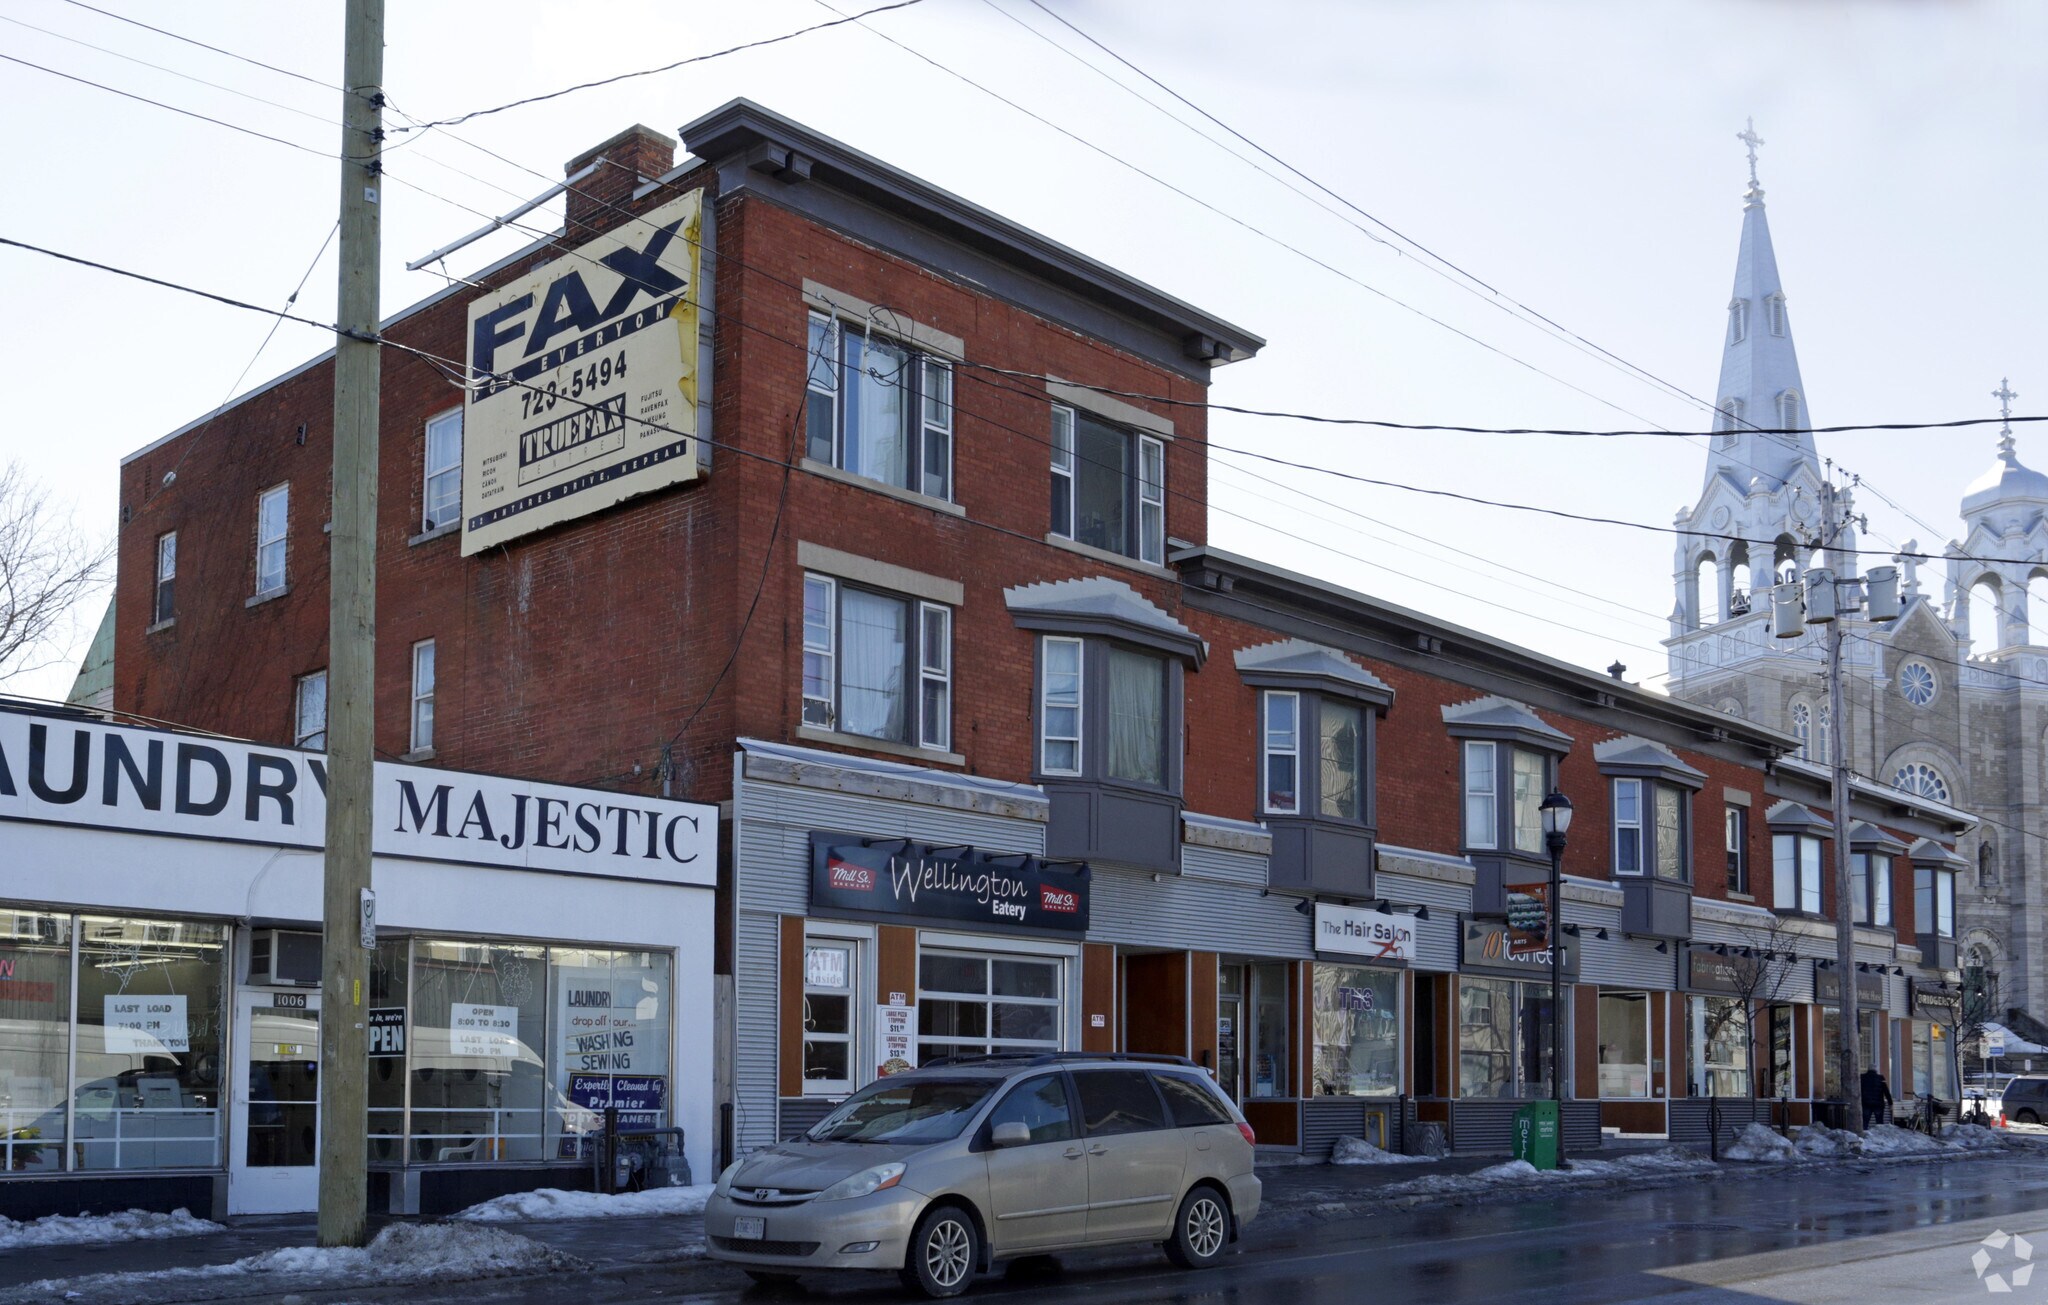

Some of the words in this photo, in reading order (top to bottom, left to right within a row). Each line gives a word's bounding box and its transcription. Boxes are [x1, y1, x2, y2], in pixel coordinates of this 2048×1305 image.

[473, 216, 689, 384] FAX
[540, 302, 664, 372] EVERYON
[521, 350, 627, 420] 723-5494
[640, 389, 663, 403] FUJITSU
[640, 400, 669, 415] RAVENFAX
[522, 397, 624, 462] TRUEFAX
[482, 451, 507, 466] MITSUBISHI
[493, 491, 552, 520] ANTARES
[563, 472, 610, 495] DRIVE,
[621, 444, 681, 474] NEPEAN
[0, 724, 327, 826] UNDR
[393, 779, 699, 864] MAJESTIC
[832, 867, 855, 881] Mill
[857, 870, 871, 884] St.
[891, 856, 1028, 904] Wellington
[1043, 891, 1064, 905] Mill
[1064, 894, 1075, 906] St.
[992, 899, 1026, 921] Eatery
[1322, 920, 1341, 935] The
[1344, 919, 1371, 938] Hair
[1374, 923, 1411, 942] Salon
[808, 951, 842, 972] ATM
[277, 994, 305, 1007] 1006
[568, 990, 611, 1008] LAUNDRY
[890, 993, 905, 1001] ATM
[114, 1004, 140, 1013] LAST
[147, 1004, 172, 1013] LOAD
[472, 1007, 494, 1017] OPEN
[385, 1012, 403, 1022] we're
[478, 1019, 490, 1027] TO
[493, 1019, 511, 1028] 8:30
[571, 1016, 594, 1028] drop
[594, 1015, 607, 1026] off
[609, 1018, 637, 1028] our...
[146, 1020, 160, 1030] PM
[133, 1039, 166, 1048] THANK
[168, 1039, 187, 1048] YOU
[370, 1024, 404, 1052] PEN
[459, 1035, 482, 1044] LAST
[581, 1052, 631, 1071] SEWING
[574, 1078, 611, 1094] Expertly
[616, 1080, 649, 1091] Cleaned
[652, 1081, 661, 1094] by
[589, 1096, 645, 1109] Premier
[599, 1114, 657, 1124] CEANERS
[1519, 1119, 1530, 1159] metr
